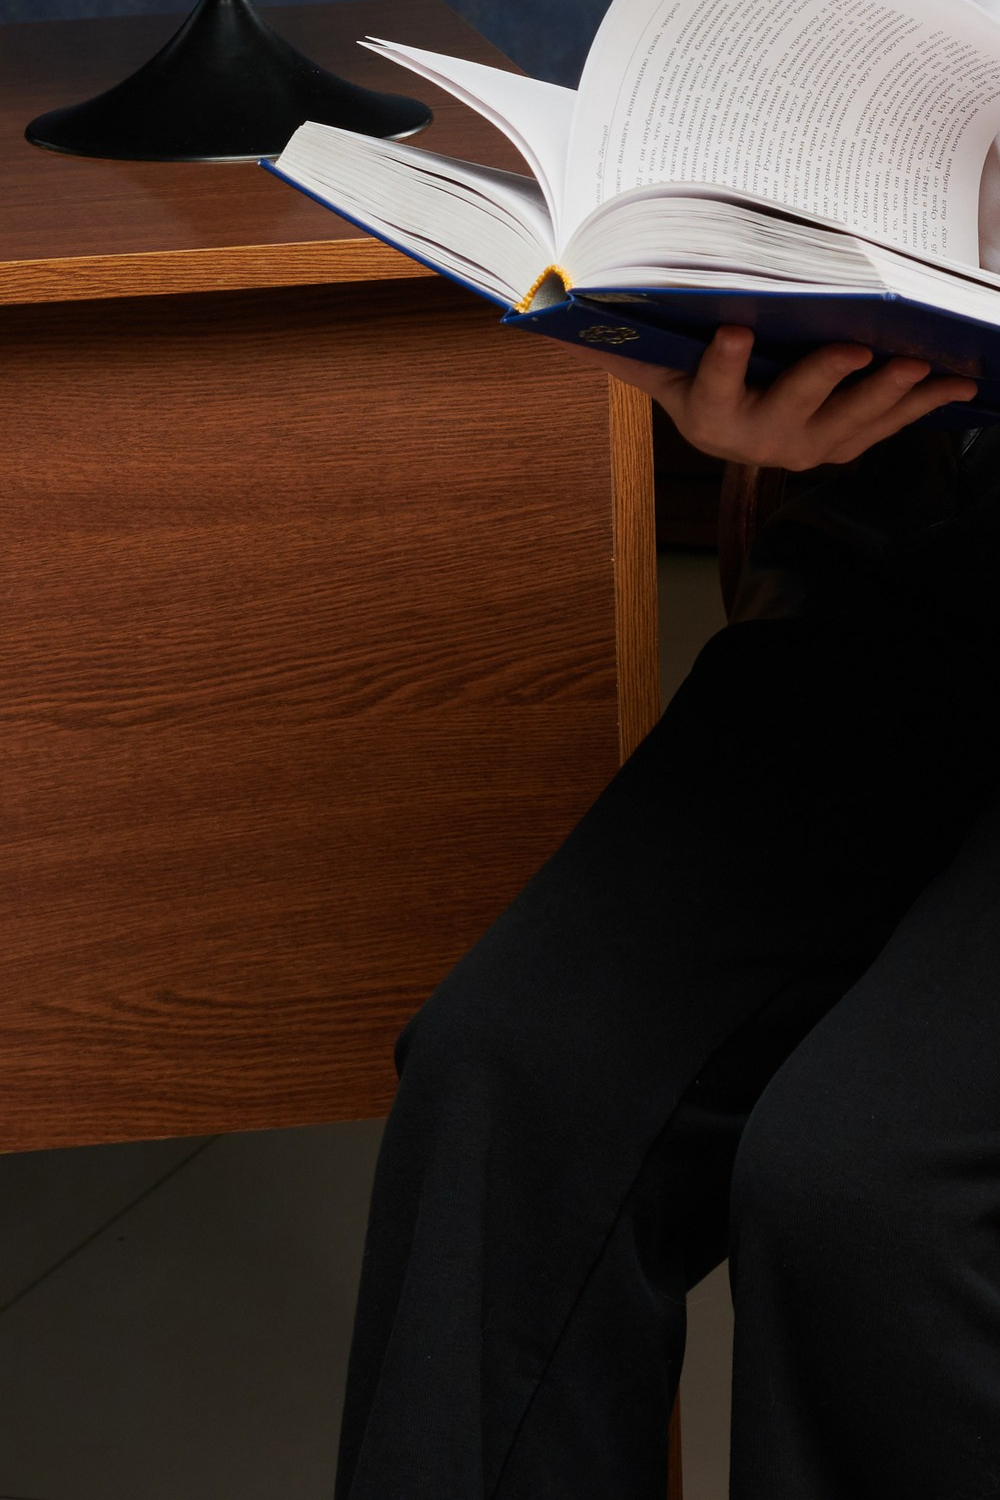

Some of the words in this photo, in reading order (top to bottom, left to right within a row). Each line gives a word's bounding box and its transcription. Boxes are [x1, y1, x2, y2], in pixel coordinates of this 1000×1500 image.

[617, 120, 630, 164] вызвать
[626, 58, 649, 117] ионизацию
[660, 2, 681, 28] через
[659, 132, 671, 172] частиц,
[694, 3, 730, 51] большими
[662, 47, 677, 73] свою
[685, 94, 703, 142] диполей,
[700, 36, 730, 90] состоящих
[703, 114, 718, 159] атомной
[714, 79, 730, 111] массе.
[726, 36, 754, 75] Твердая
[753, 0, 784, 34] материя
[710, 61, 728, 93] знака,
[722, 146, 731, 175] всего
[727, 109, 741, 142] атома.
[736, 85, 750, 104] Эта
[747, 49, 769, 81] работа
[768, 17, 794, 46] внесла
[736, 54, 753, 83] около
[752, 26, 774, 52] одной
[745, 130, 756, 156] годы
[767, 52, 790, 86] изучал
[788, 15, 820, 50] природу
[766, 83, 784, 118] линий.
[780, 38, 813, 79] Развивая
[811, 11, 837, 36] труды
[865, 100, 884, 134] работе
[882, 57, 919, 98] вызывают
[649, 147, 658, 172] того,
[663, 64, 681, 100] назвал
[670, 129, 682, 175] частицы
[677, 94, 692, 128] имели
[688, 62, 704, 92] массу
[763, 137, 776, 172] Рунге,
[771, 90, 791, 133] которые
[774, 130, 787, 174] металла
[784, 93, 800, 125] могут
[783, 157, 792, 189] серий
[795, 89, 813, 124] между
[811, 47, 841, 88] длинами
[807, 126, 820, 157] серии
[813, 167, 821, 198] атома
[825, 92, 845, 129] именно
[843, 72, 857, 90] эти
[896, 127, 913, 171] получил
[911, 77, 949, 123] множество
[923, 82, 956, 121] доктором
[795, 140, 806, 172] явная
[803, 159, 812, 200] каждой
[823, 159, 832, 192] серию
[861, 191, 869, 219] Одни
[866, 117, 886, 168] открытия
[882, 90, 902, 115] были
[905, 124, 925, 175] почетным
[912, 167, 921, 206] (теперь
[917, 131, 932, 161] Осло)
[936, 96, 954, 114] 1911
[921, 175, 930, 198] 1942
[928, 117, 950, 159] получил
[930, 194, 938, 221] Орла
[934, 117, 960, 170] Немецкого
[942, 158, 953, 194] избран
[950, 107, 980, 153] почетным
[872, 171, 882, 224] важными,
[902, 178, 910, 225] назначен
